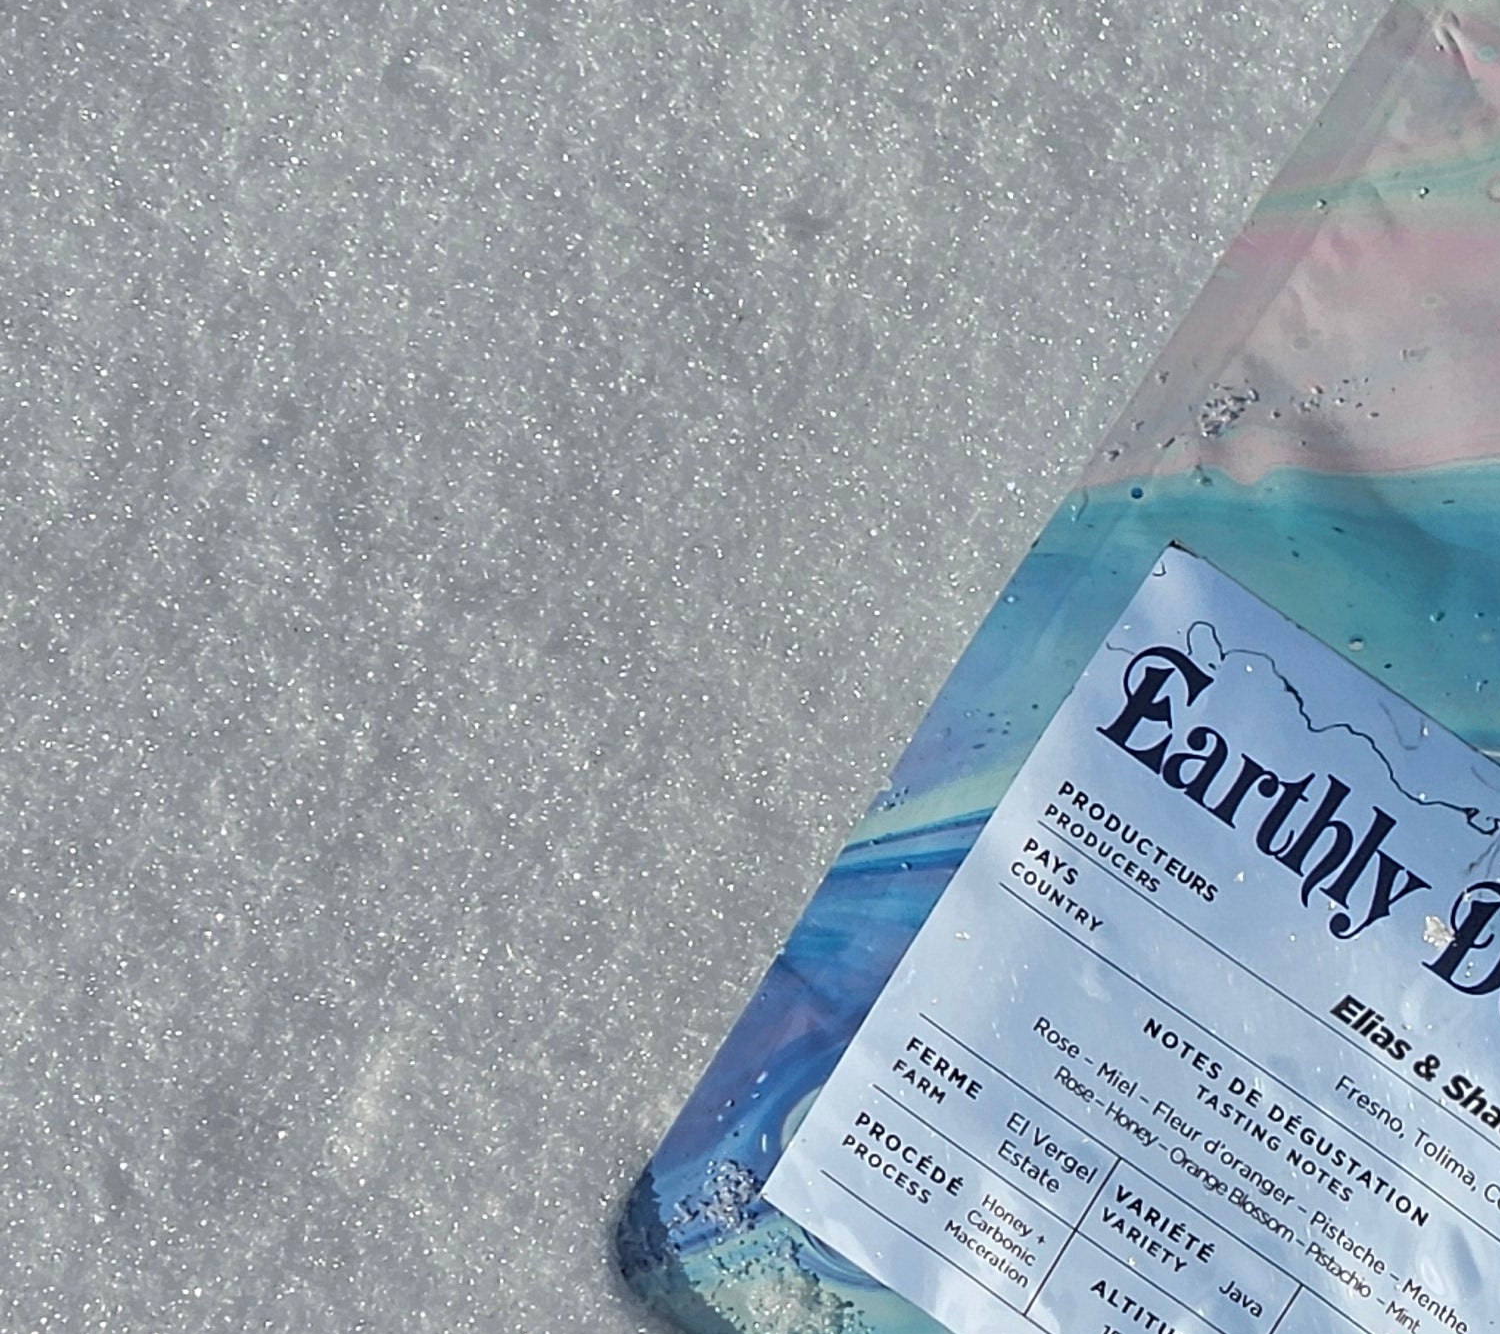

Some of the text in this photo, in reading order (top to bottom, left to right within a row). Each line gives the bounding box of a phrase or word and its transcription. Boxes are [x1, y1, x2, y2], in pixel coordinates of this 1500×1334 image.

[1096, 646, 1432, 939] Earthly
[1022, 838, 1079, 886] PAYS
[1044, 804, 1161, 894] PRODUCERS
[1058, 781, 1218, 903] PRODUCTEURS
[1010, 861, 1104, 934] COUNTRY
[906, 1036, 983, 1100] FERME
[1330, 995, 1412, 1061] Elias
[1413, 1054, 1441, 1082] &
[892, 1059, 946, 1104] FARM
[854, 1112, 964, 1197] PROCÉDÉ
[1006, 1112, 1098, 1184] El Vergel
[1033, 1017, 1080, 1058] Rose
[1097, 1062, 1138, 1098] Miel
[1152, 1101, 1202, 1142] Fleur
[1203, 1138, 1294, 1206] d'oranger
[1310, 1211, 1385, 1275] Pistache
[1143, 1018, 1429, 1227] NOTES DE DÉGUSTATION
[1196, 1084, 1354, 1202] TASTING NOTES
[1335, 1075, 1406, 1139] Fresno,
[1415, 1128, 1478, 1193] Tolima,
[842, 1134, 932, 1204] PROCESS
[997, 1139, 1060, 1193] Estate
[1054, 1065, 1095, 1103] Rose
[1105, 1101, 1159, 1147] Honey
[1169, 1147, 1228, 1196] Orange
[1228, 1187, 1294, 1243] Blossom
[1305, 1241, 1372, 1298] Pistachio
[1385, 1300, 1421, 1334] Mint
[966, 1209, 1036, 1267] Carbonic
[981, 1194, 1033, 1238] Honey
[1101, 1207, 1188, 1273] VARIETY
[1116, 1185, 1215, 1264] VARIÉTÉ
[944, 1220, 1029, 1288] Maceration
[1218, 1281, 1263, 1318] Java
